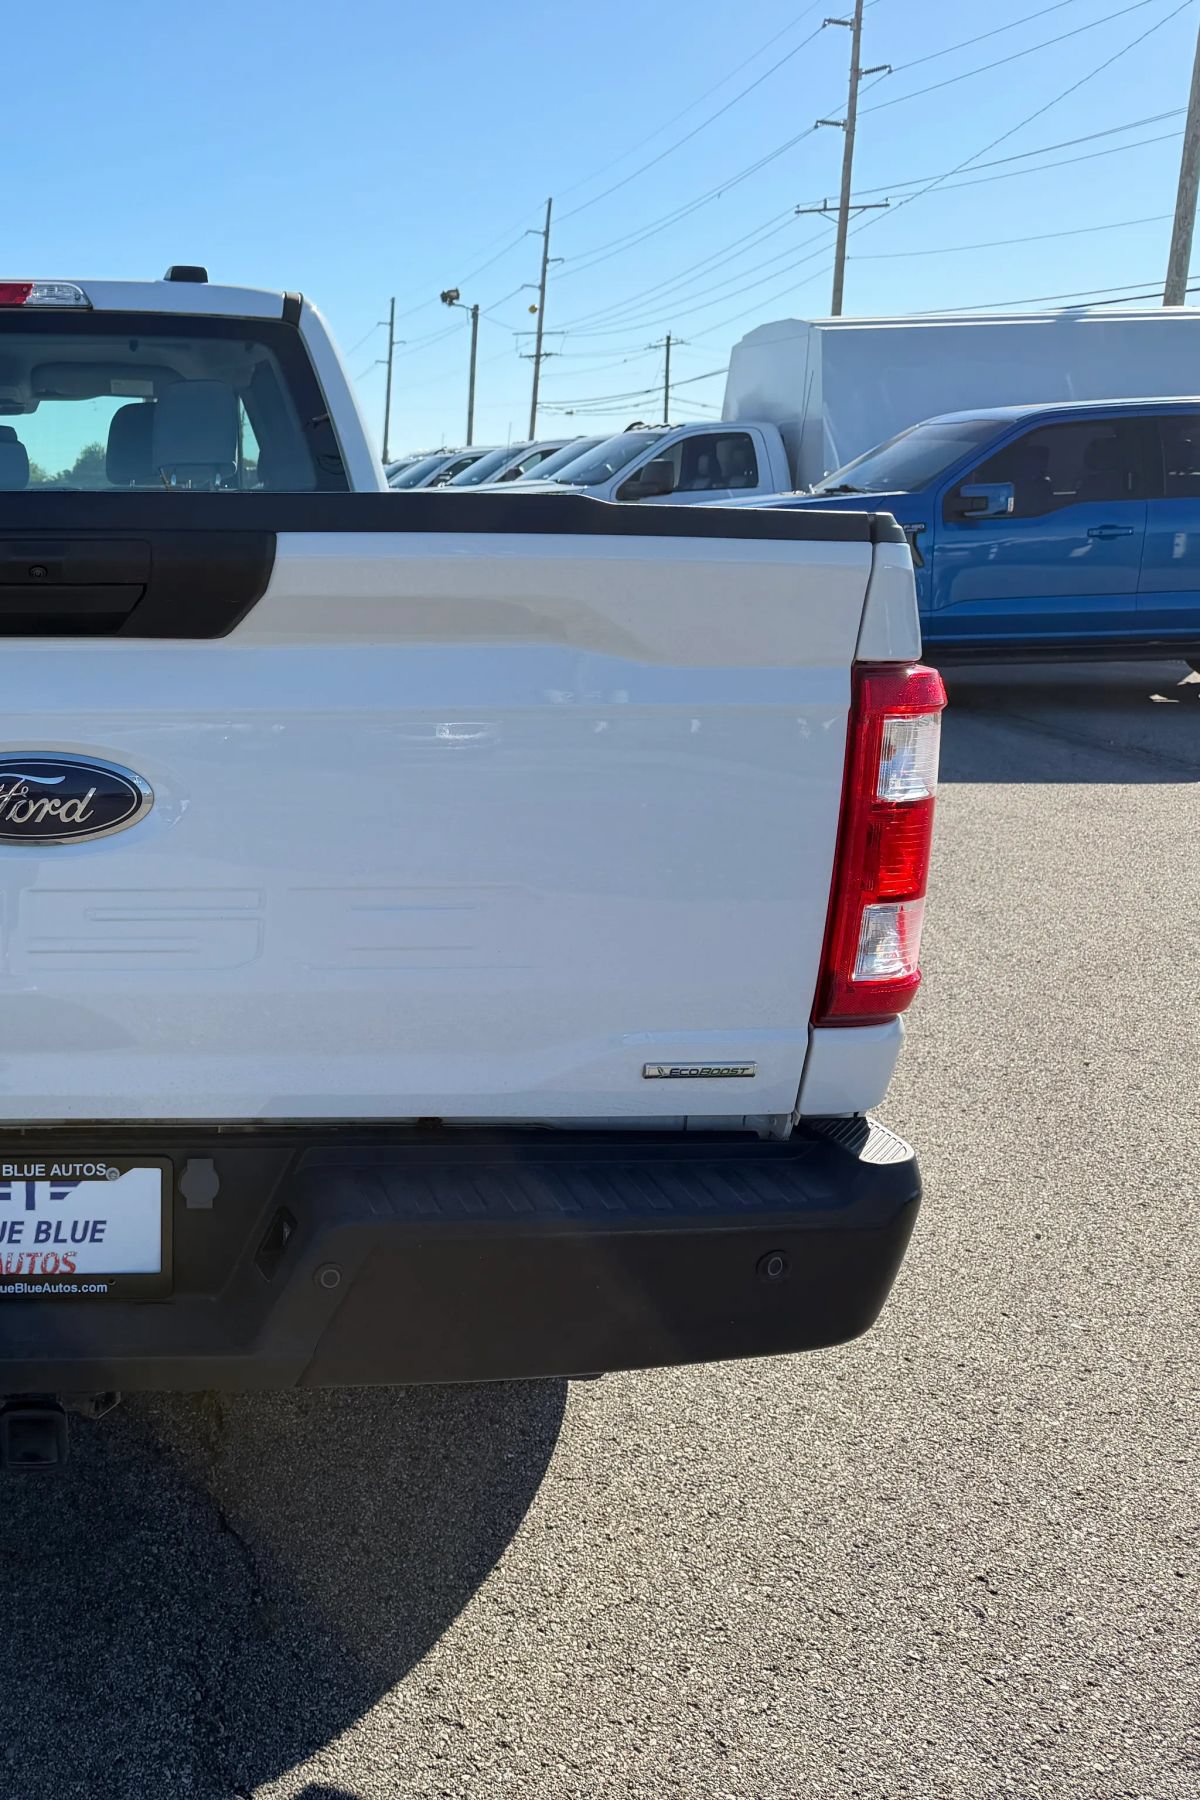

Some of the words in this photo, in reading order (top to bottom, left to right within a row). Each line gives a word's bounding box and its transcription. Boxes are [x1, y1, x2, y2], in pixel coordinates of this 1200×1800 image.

[2, 1164, 46, 1177] BLUE
[50, 1163, 107, 1176] AUTOS
[33, 1220, 107, 1244] BLUE
